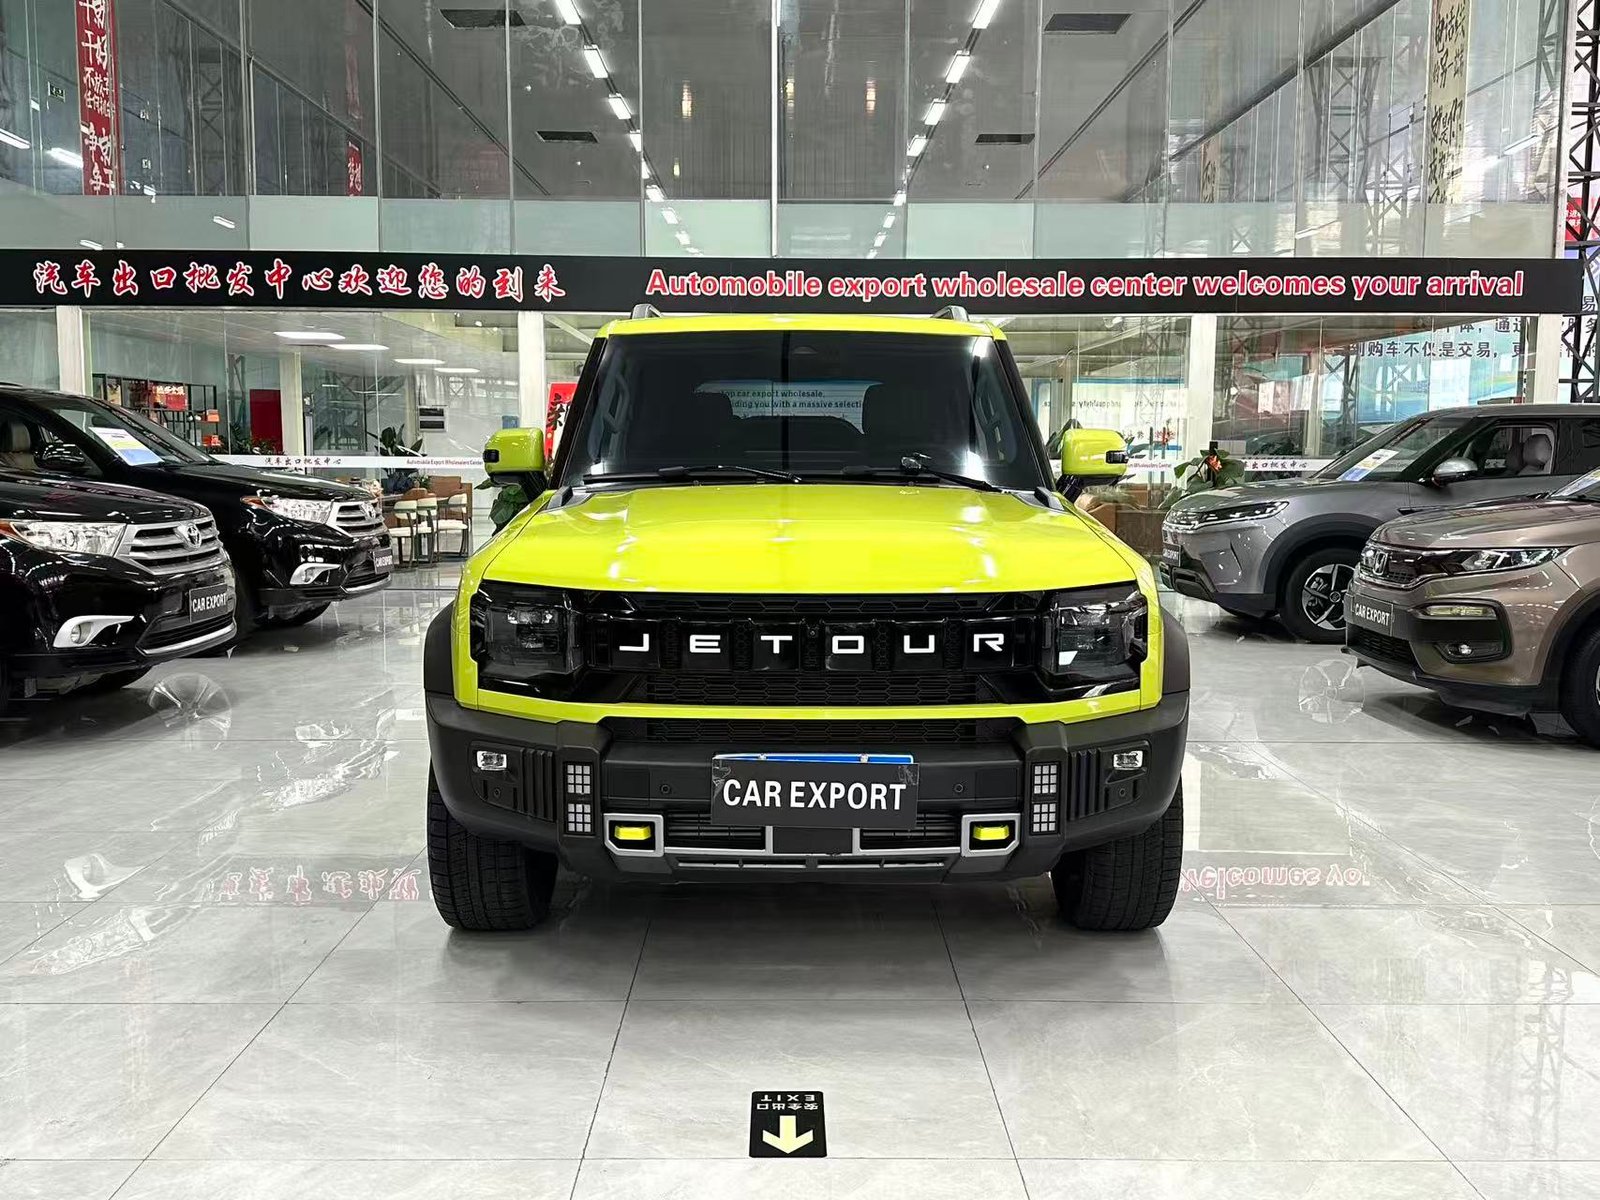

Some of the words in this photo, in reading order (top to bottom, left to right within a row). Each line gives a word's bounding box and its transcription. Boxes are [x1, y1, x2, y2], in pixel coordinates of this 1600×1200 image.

[34, 258, 566, 302] 汽车出口批发中心欢迎您的到来
[646, 269, 822, 296] Automobile
[828, 273, 926, 302] export
[932, 271, 1084, 297] wholesale
[1090, 272, 1187, 297] center
[1194, 270, 1345, 296] welcomes
[1352, 275, 1420, 301] your
[1426, 271, 1524, 296] arrival
[752, 390, 778, 398] export
[773, 400, 791, 408] with
[799, 400, 833, 408] massive
[193, 598, 206, 612] CAR
[206, 592, 227, 609] EXPORT
[1355, 603, 1366, 618] CAR
[1366, 606, 1390, 626] EXPORT
[619, 633, 1005, 655] JETOUR
[723, 779, 782, 807] CAR
[790, 782, 907, 810] EXPORT
[757, 1102, 818, 1111] 安全出口
[761, 1094, 815, 1102] EXIT
